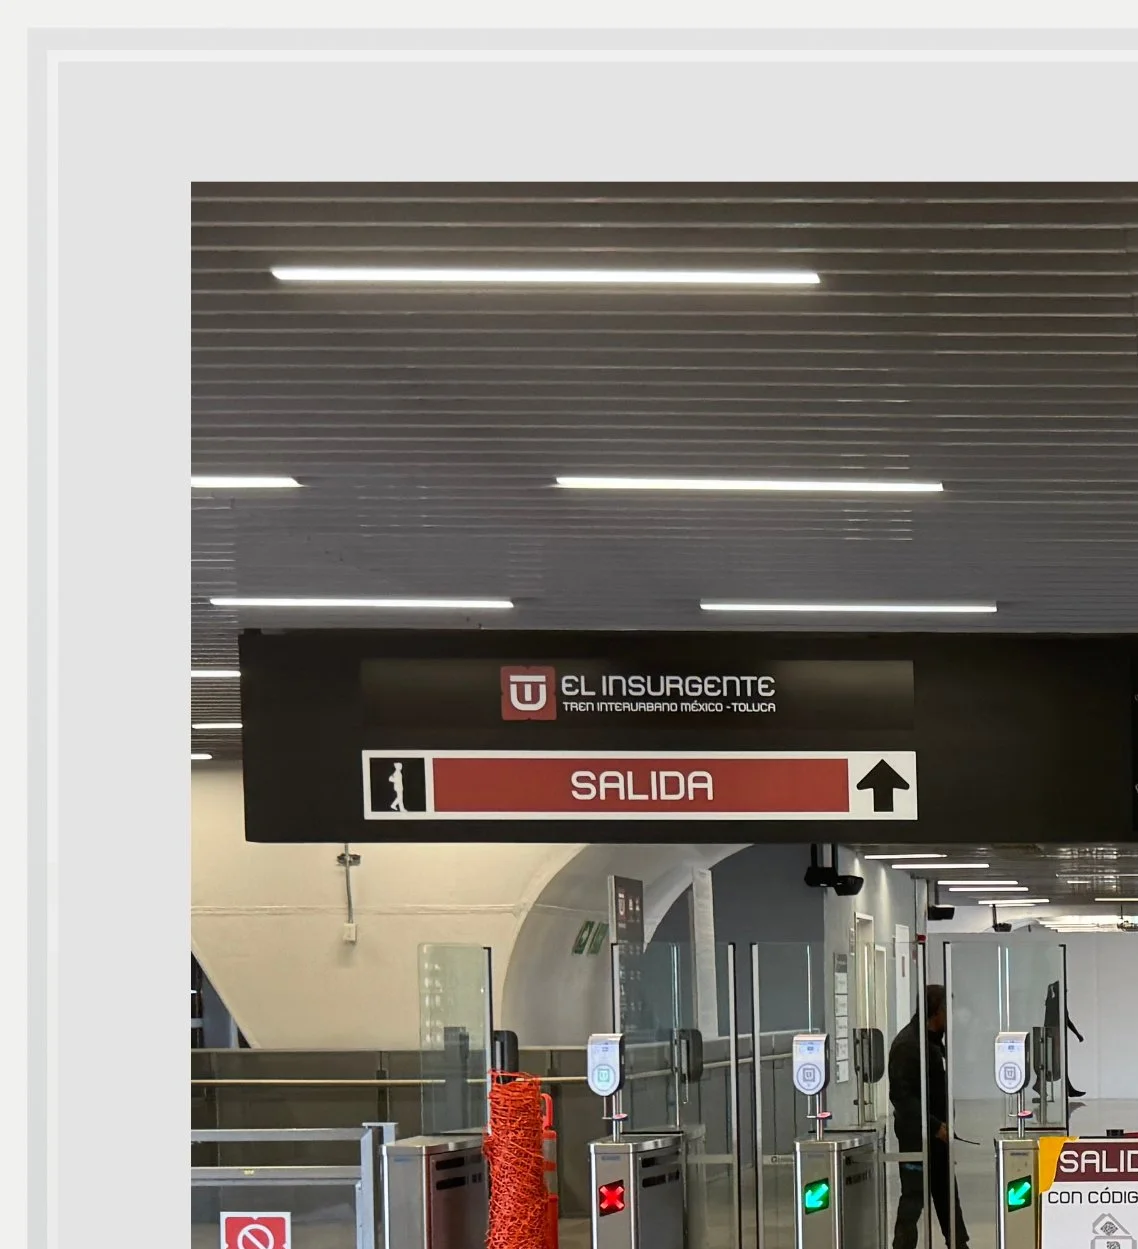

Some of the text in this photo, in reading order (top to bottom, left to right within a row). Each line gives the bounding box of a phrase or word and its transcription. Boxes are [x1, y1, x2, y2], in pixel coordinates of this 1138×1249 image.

[561, 675, 776, 698] EL INSURGENTE
[562, 701, 595, 713] TREN
[597, 701, 678, 713] INTERURBANO
[680, 699, 724, 713] MÉXICO
[571, 770, 714, 801] SALIDA
[1048, 1190, 1083, 1204] CON
